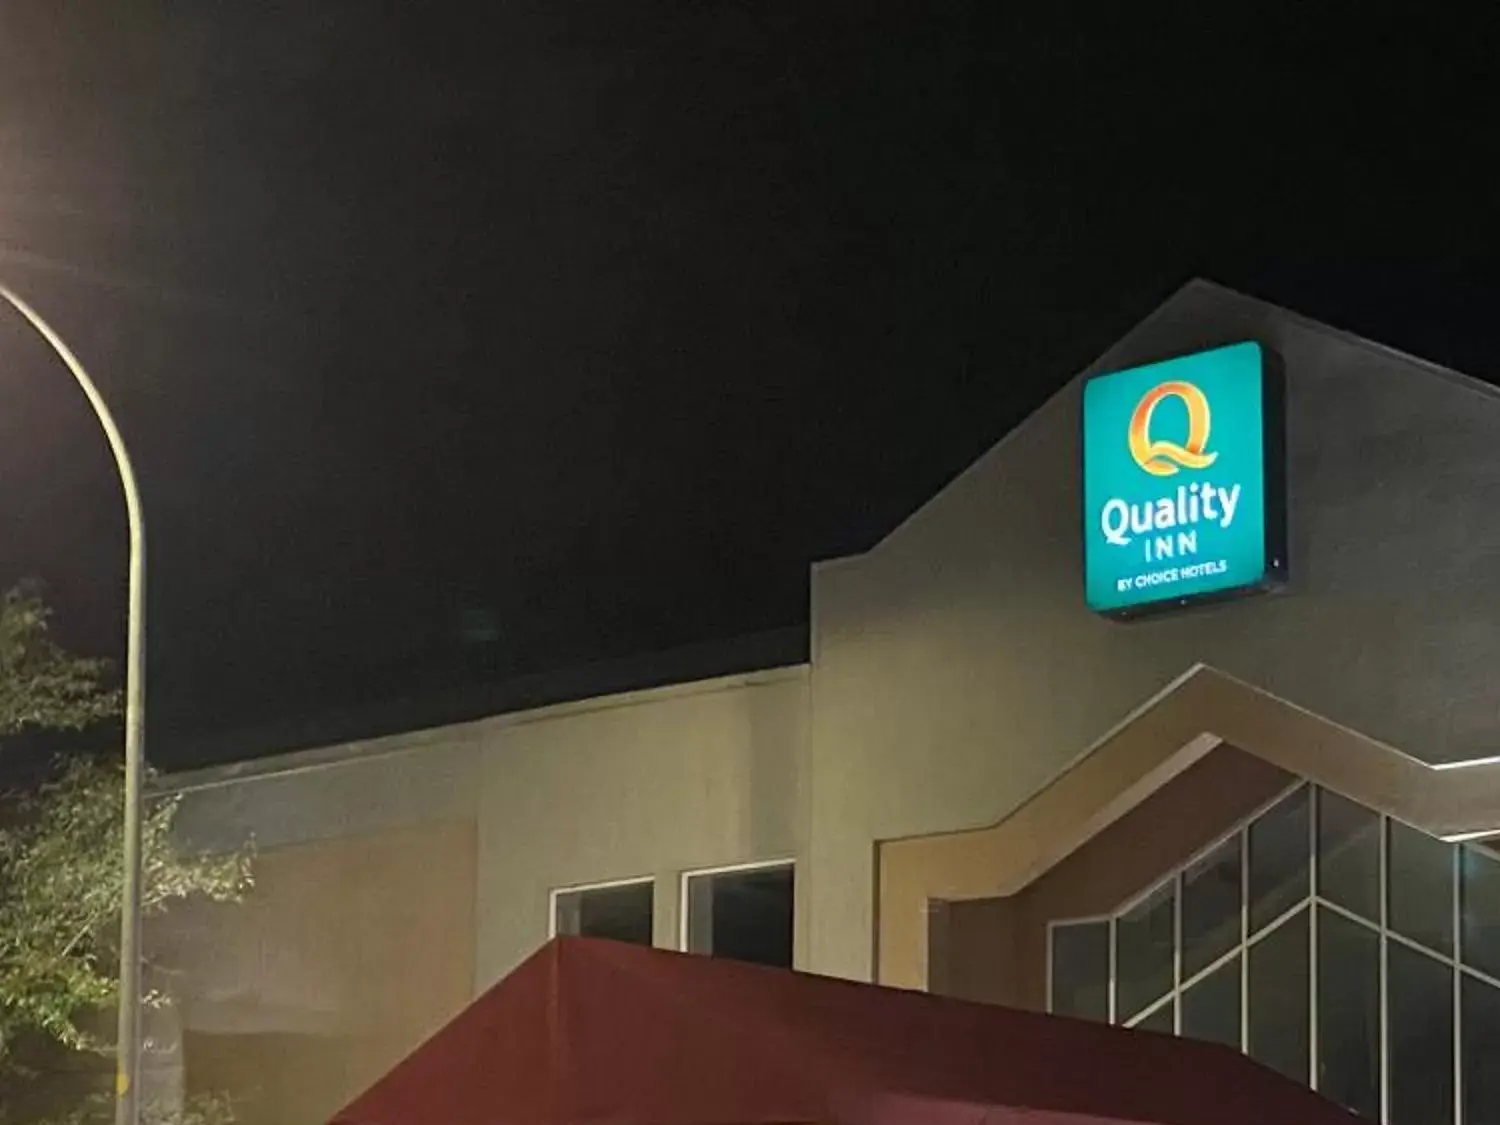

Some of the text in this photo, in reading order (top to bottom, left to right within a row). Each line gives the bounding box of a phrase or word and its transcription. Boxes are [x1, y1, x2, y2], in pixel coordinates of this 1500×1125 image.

[1129, 381, 1218, 475] Q
[1101, 482, 1240, 545] Quality
[1145, 530, 1198, 563] INN
[1117, 560, 1227, 592] BY CHOICE HOTELS
